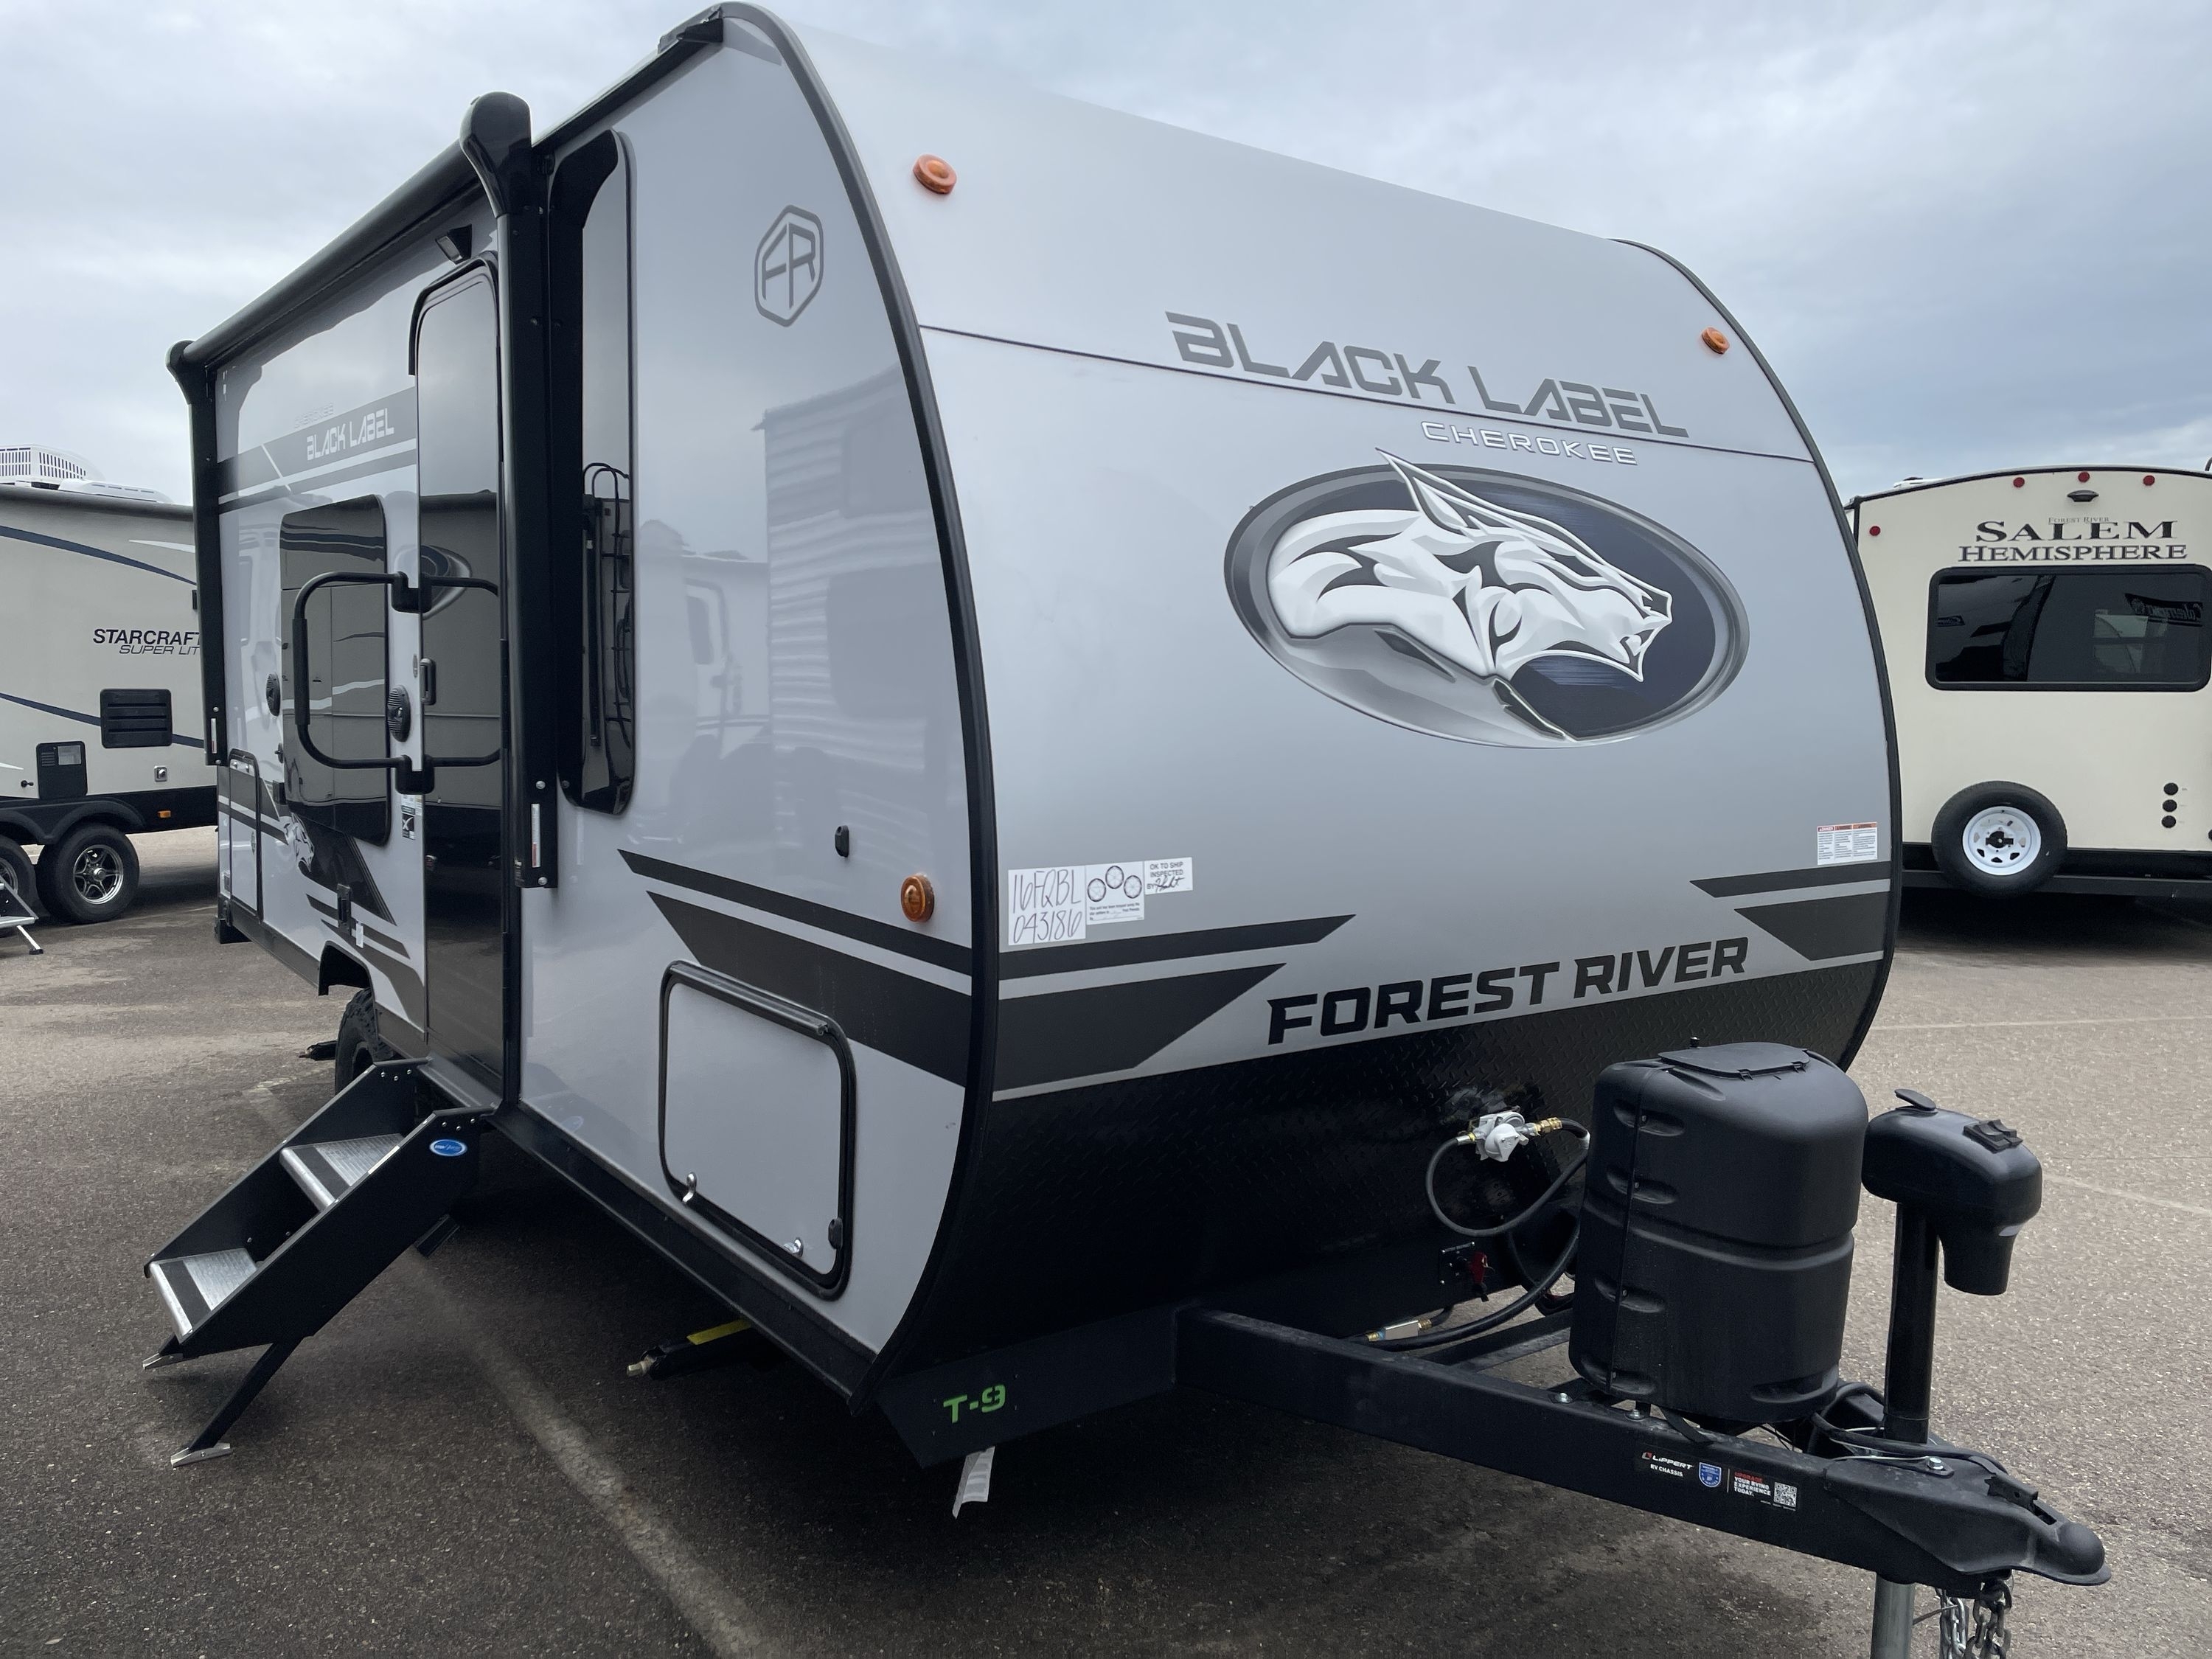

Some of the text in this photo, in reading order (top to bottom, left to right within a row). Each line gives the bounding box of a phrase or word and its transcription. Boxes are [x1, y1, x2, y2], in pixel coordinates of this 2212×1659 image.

[1165, 311, 1690, 439] BLACK LABEL
[307, 408, 395, 461] BLACK LABEL
[1421, 421, 1638, 466] CHEROKEE
[1976, 521, 2178, 542] SALEM
[1958, 544, 2188, 562] HEMISPHERE
[119, 645, 175, 655] SUPER
[1150, 869, 1183, 877] INSPECTED
[1267, 937, 1749, 1045] FOREST RIVER
[1652, 1455, 1694, 1469] LIPPERT
[1658, 1466, 1683, 1478] CHASSIS
[1734, 1476, 1750, 1485] YOUR
[1734, 1481, 1771, 1496] EXPERIENCE
